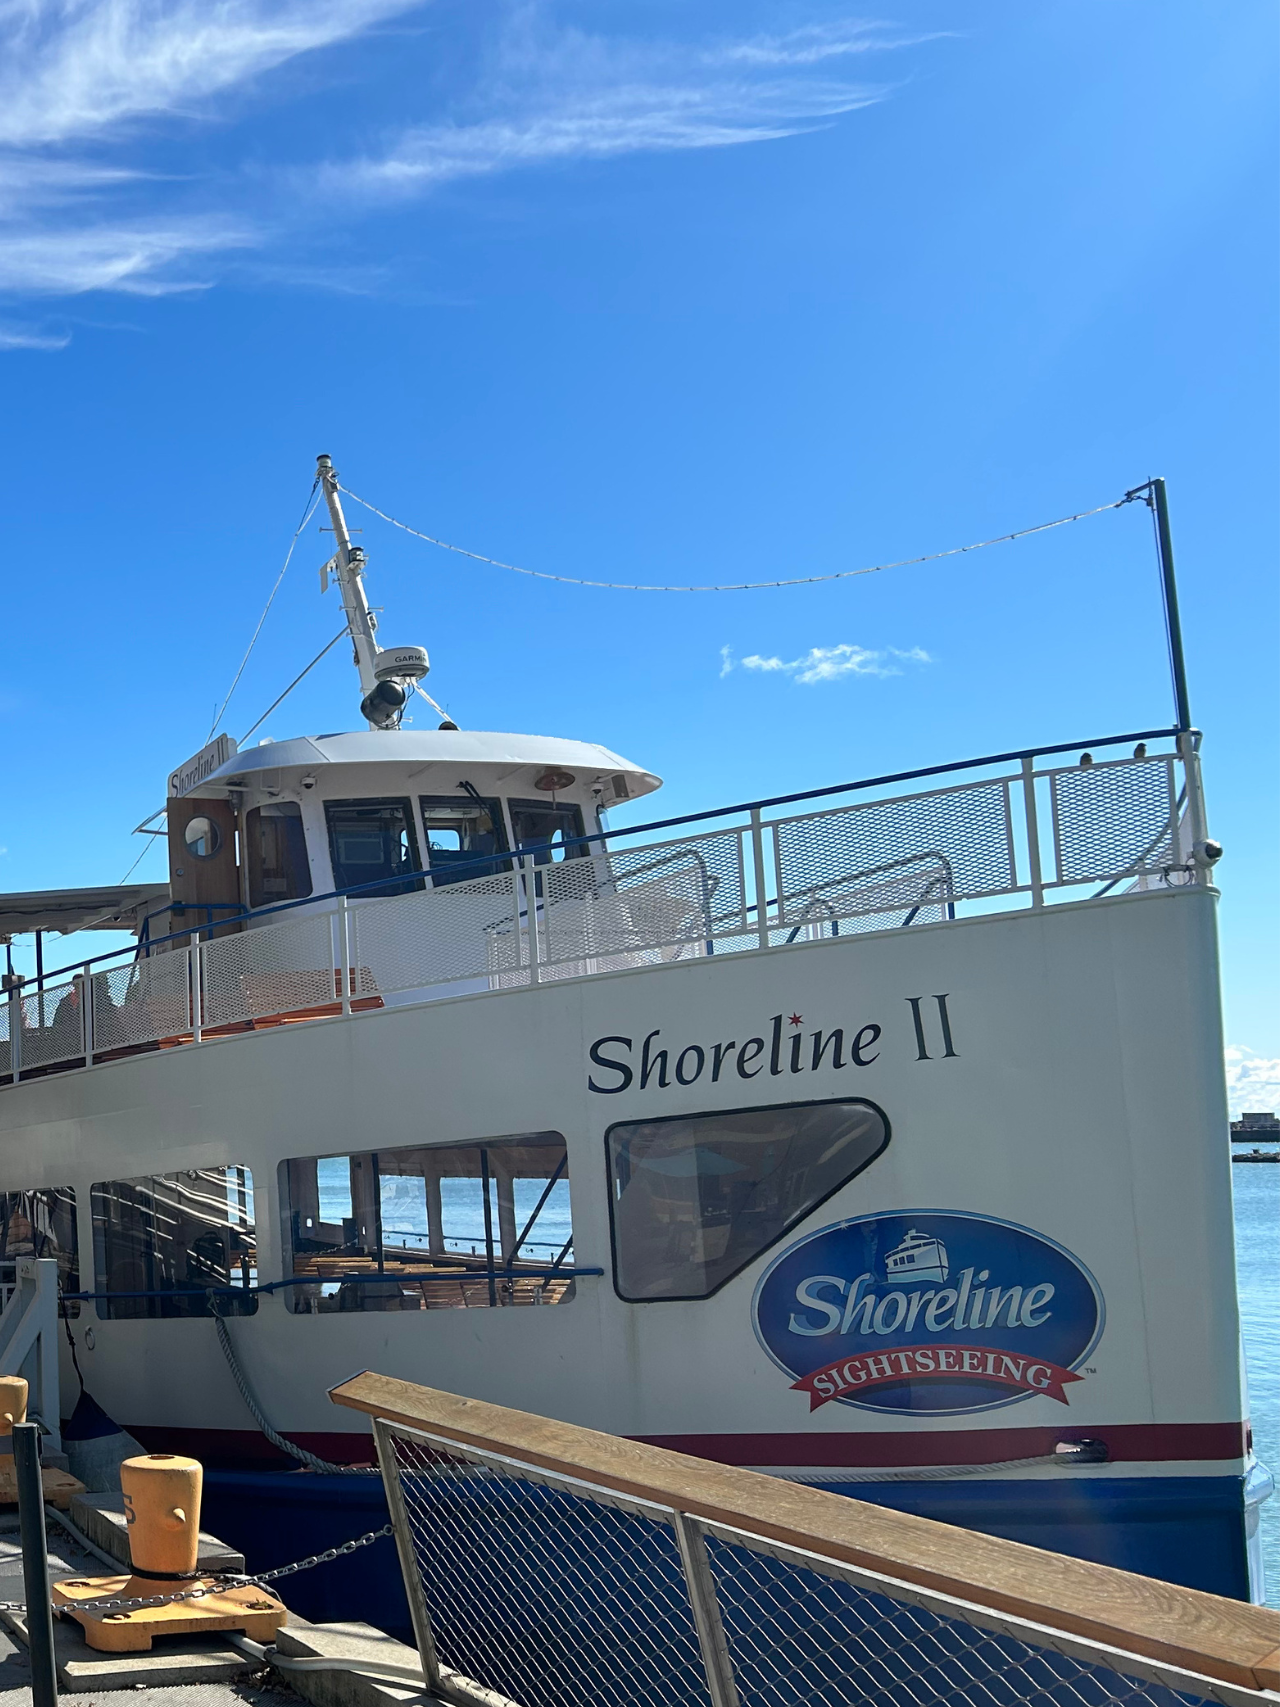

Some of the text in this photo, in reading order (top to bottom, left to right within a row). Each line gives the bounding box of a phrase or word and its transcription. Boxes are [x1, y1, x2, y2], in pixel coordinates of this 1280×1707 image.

[171, 754, 215, 798] Shoreline
[588, 993, 961, 1095] Shoreline II
[788, 1266, 1056, 1337] Shoreline
[812, 1349, 1052, 1399] SIGHTSEEING
